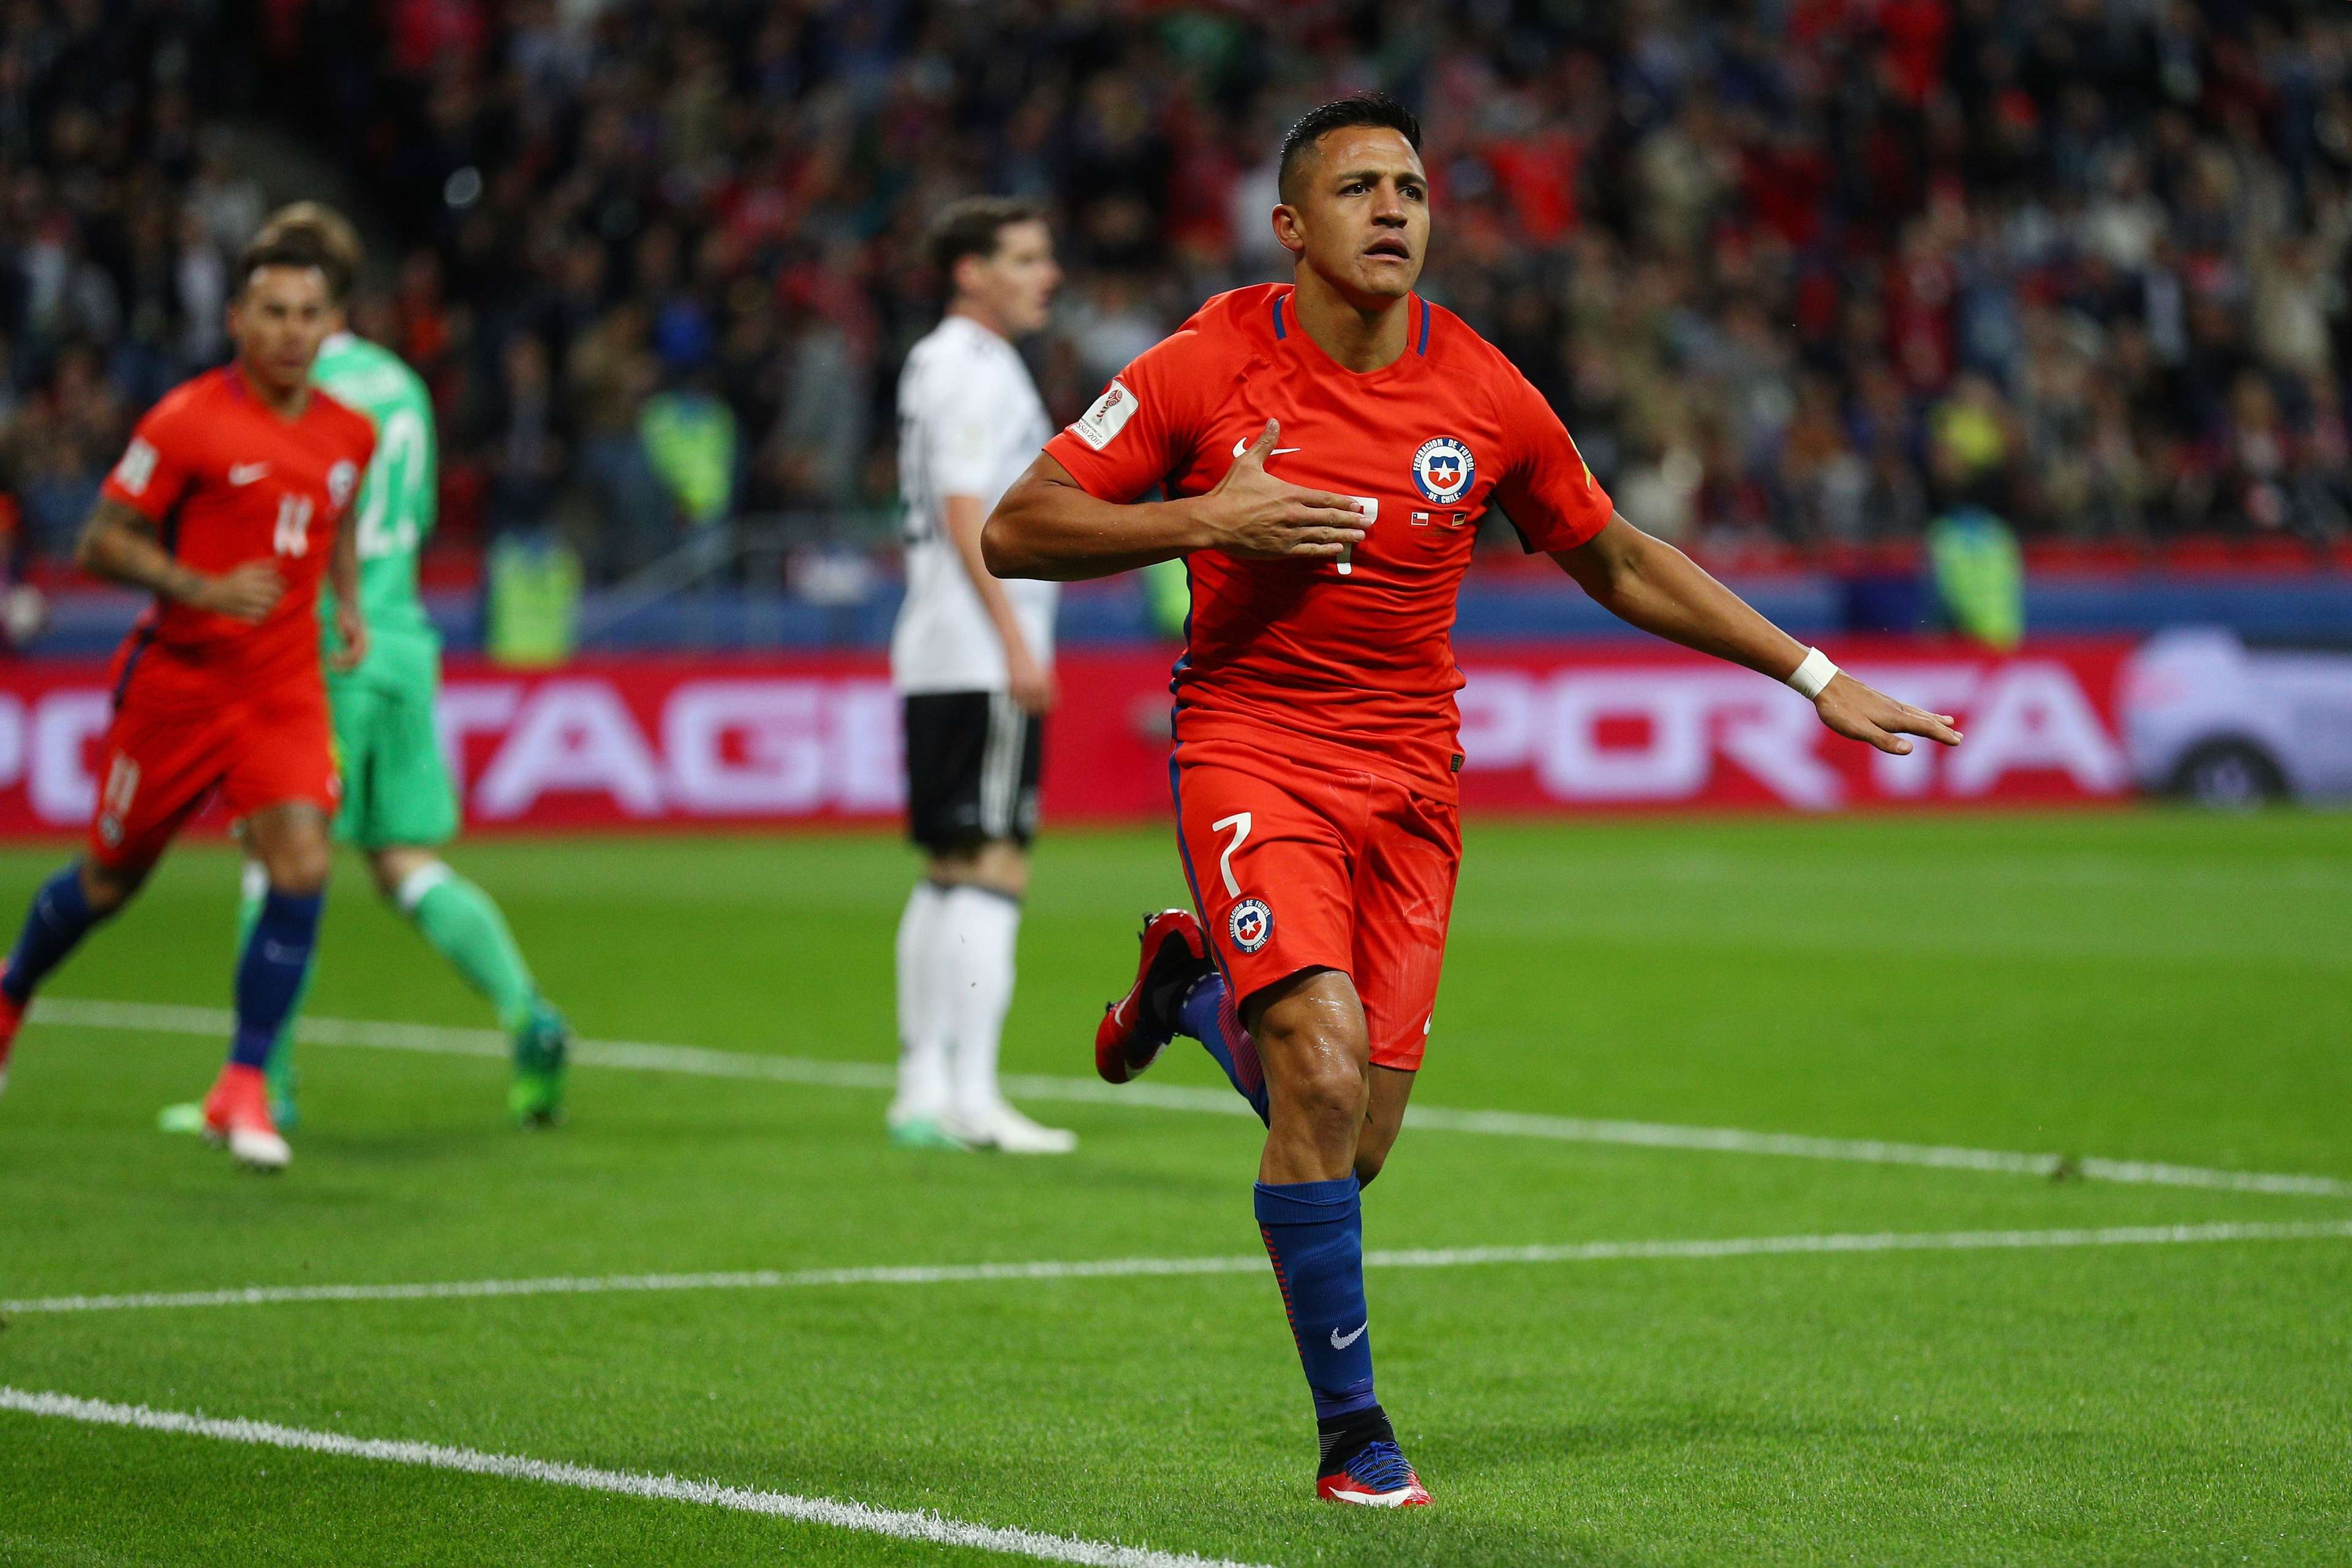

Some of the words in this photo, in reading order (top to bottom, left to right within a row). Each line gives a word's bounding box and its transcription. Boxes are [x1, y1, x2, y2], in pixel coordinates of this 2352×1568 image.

[1087, 432, 1103, 445] 2017
[1413, 439, 1443, 471] FEDERACION
[1448, 439, 1458, 448] DE
[1459, 446, 1474, 472] FUTBOL
[1428, 492, 1438, 502] DE
[1441, 494, 1460, 503] CHILE
[1212, 812, 1251, 899] 7
[1229, 903, 1244, 938] FEDERACION
[1255, 900, 1271, 918] FUTBOL
[1254, 937, 1267, 951] CHILE
